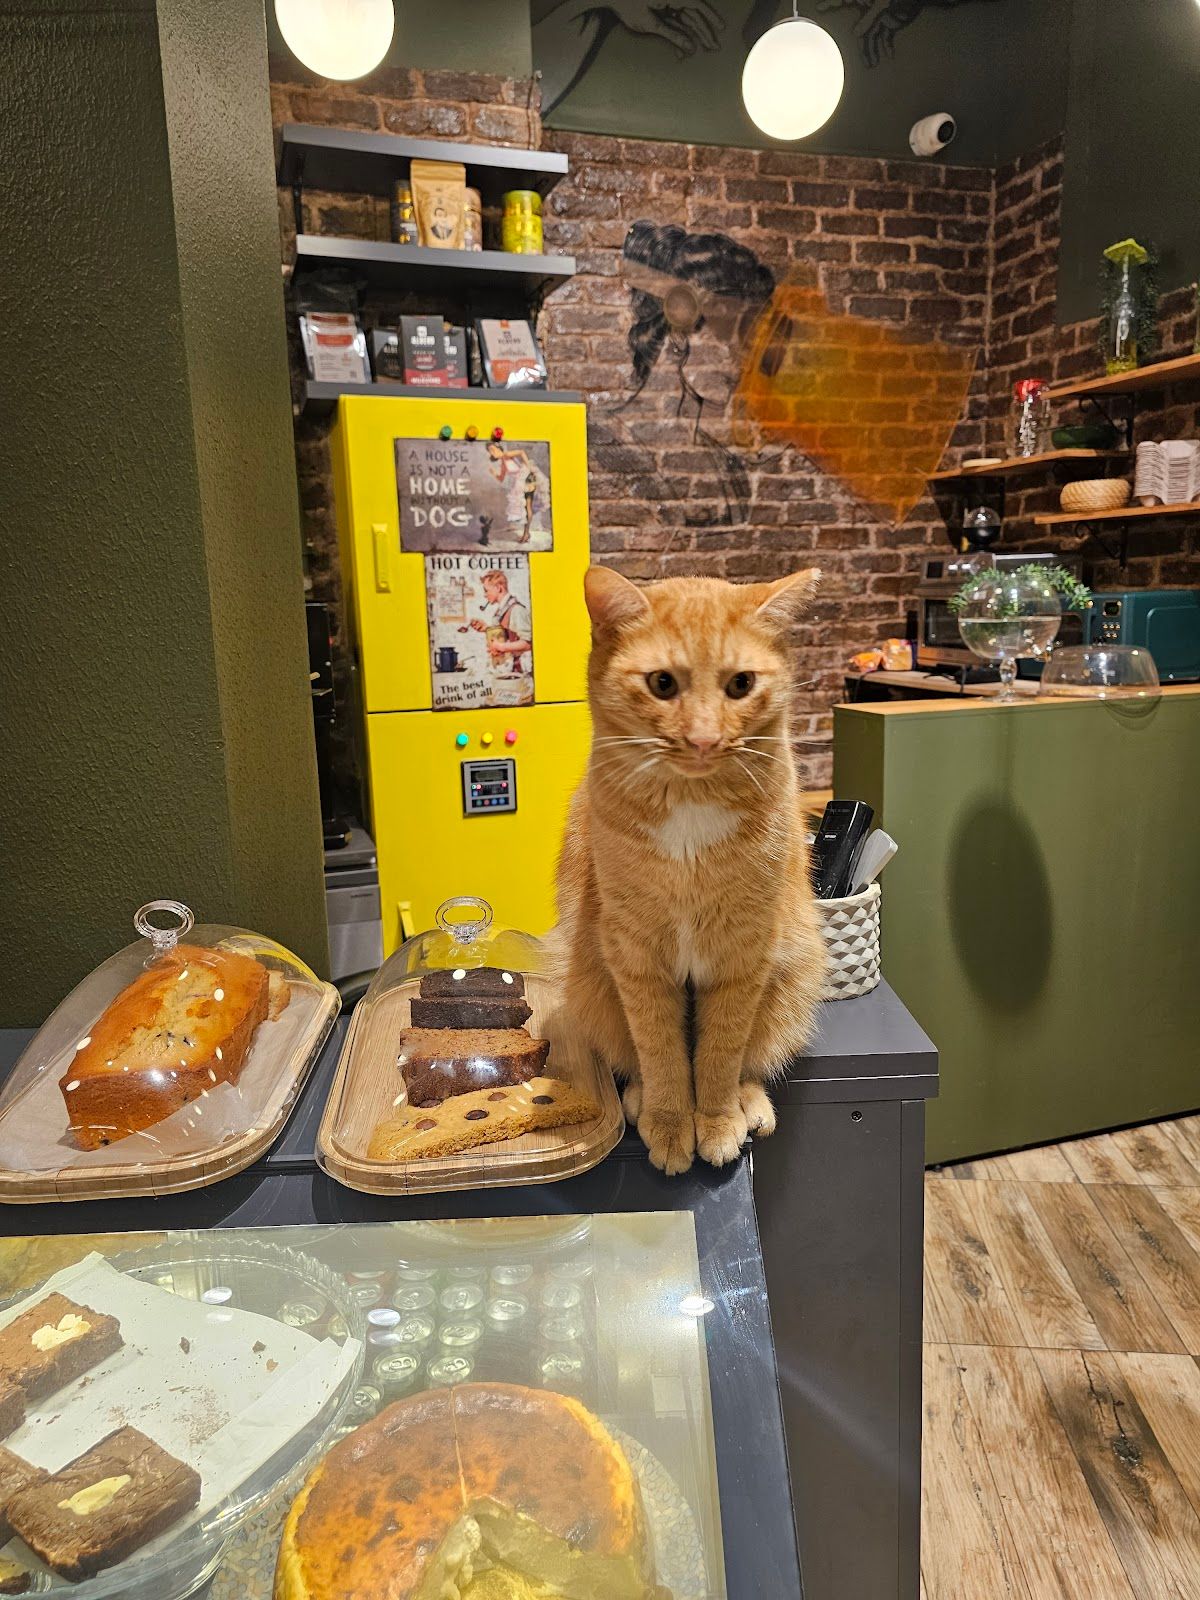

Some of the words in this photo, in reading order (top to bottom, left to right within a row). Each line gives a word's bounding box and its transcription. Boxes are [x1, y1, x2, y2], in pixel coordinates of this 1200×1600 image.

[409, 450, 419, 461] A
[425, 449, 469, 462] HOUSE
[409, 464, 423, 476] IS
[429, 464, 456, 476] NOT
[461, 465, 470, 477] A
[409, 476, 472, 496] HOME
[409, 505, 474, 528] DOG
[431, 557, 463, 570] HOT
[468, 556, 524, 569] COFFEE
[440, 685, 459, 694] The
[462, 680, 484, 691] best
[435, 693, 464, 705] drink
[466, 690, 477, 700] of
[480, 687, 493, 697] all
